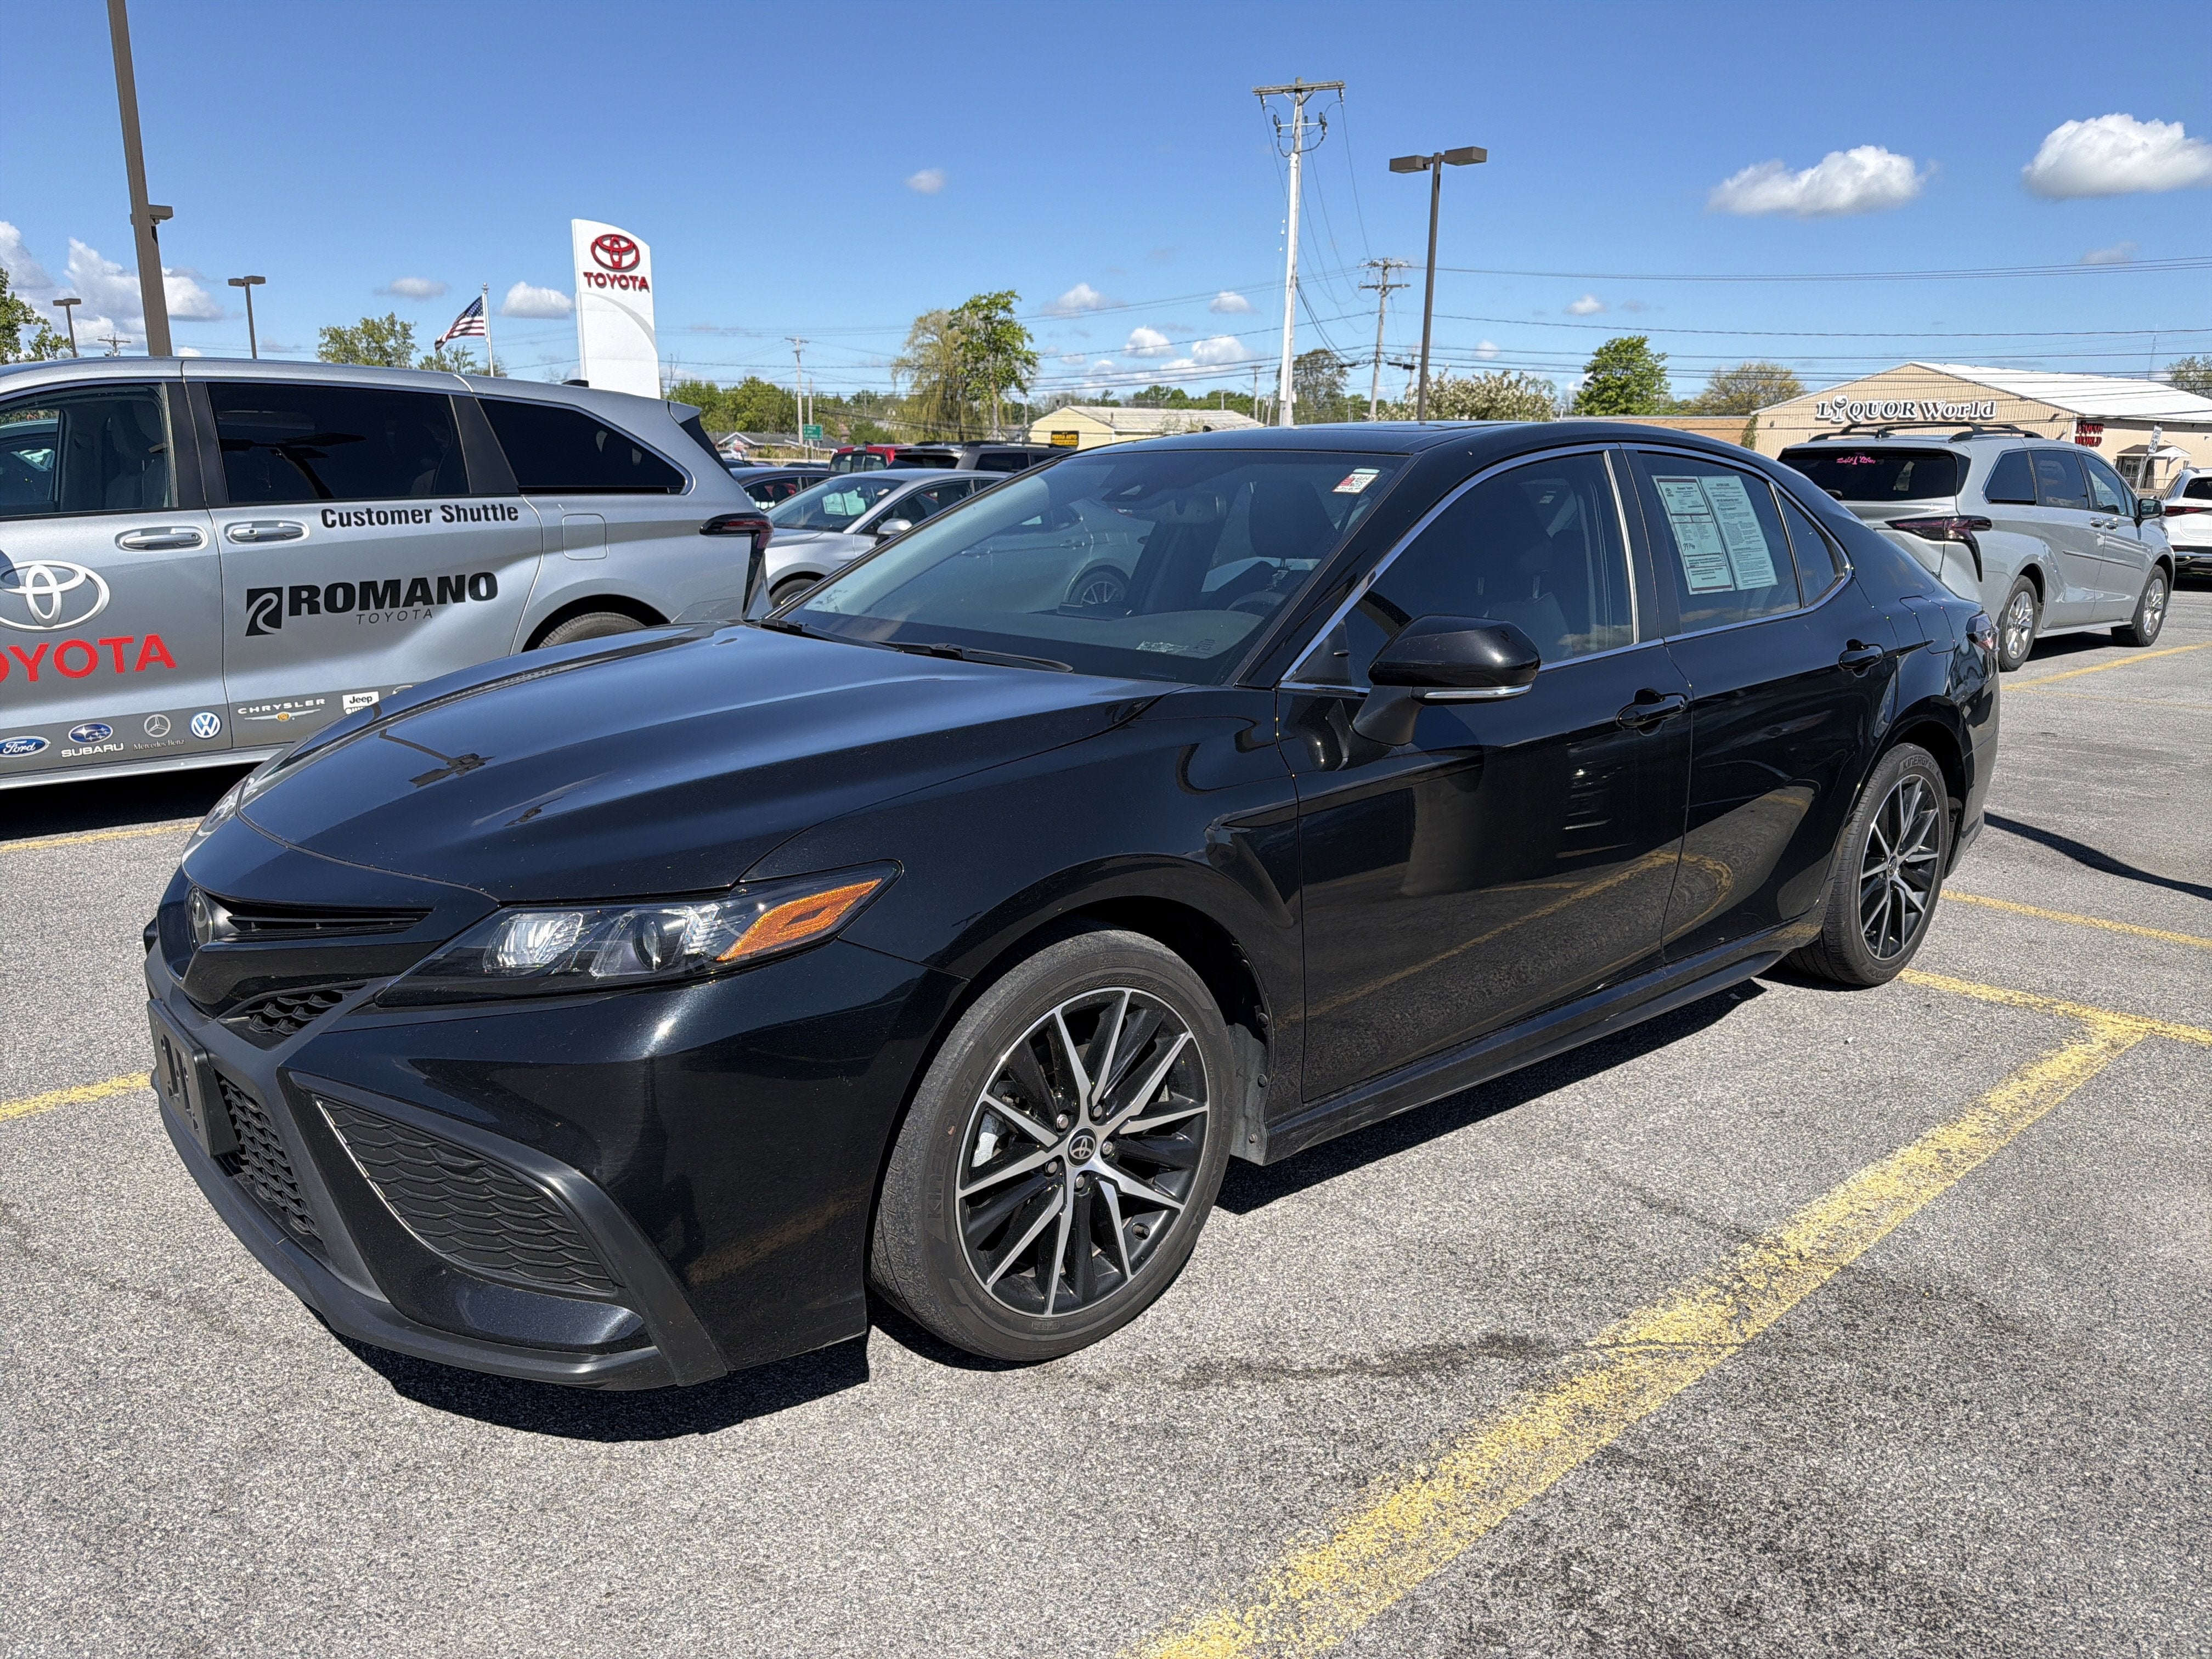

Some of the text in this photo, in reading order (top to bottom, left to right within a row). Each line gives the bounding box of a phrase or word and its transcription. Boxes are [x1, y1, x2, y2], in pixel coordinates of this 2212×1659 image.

[583, 272, 650, 292] TOYOTA
[1921, 400, 1997, 421] World
[2149, 440, 2158, 450] 30
[321, 503, 518, 528] Customer Shuttle
[289, 572, 498, 616] ROMANO
[356, 608, 433, 625] TOYOTA
[0, 633, 177, 682] YOTA
[238, 698, 325, 714] CHRYSLER
[349, 695, 373, 704] Jeep
[3, 740, 37, 754] Ford
[61, 742, 125, 758] SUBARU
